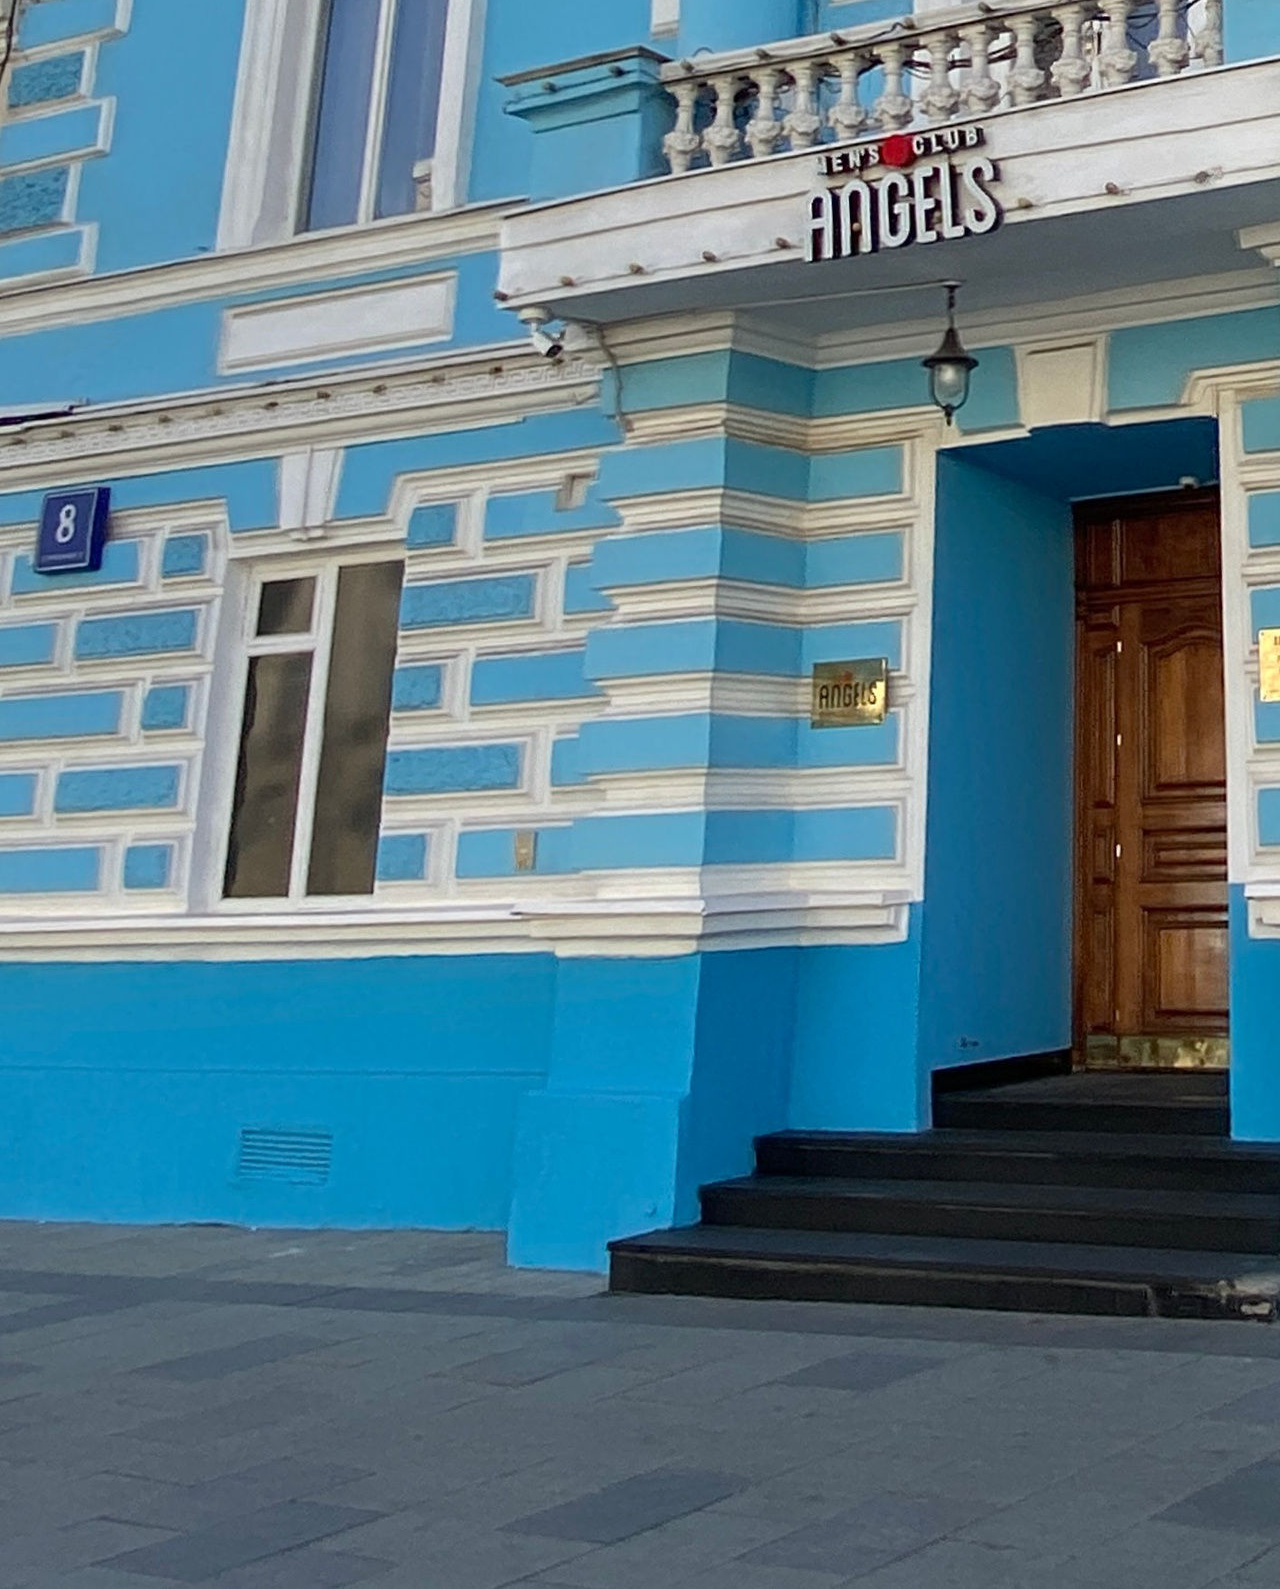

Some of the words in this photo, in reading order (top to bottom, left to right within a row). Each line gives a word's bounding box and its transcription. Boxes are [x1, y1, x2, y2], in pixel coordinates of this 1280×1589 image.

[912, 126, 984, 156] CLUB
[803, 157, 999, 262] ANGELS
[56, 504, 76, 543] 8
[819, 680, 878, 710] ANGELS
